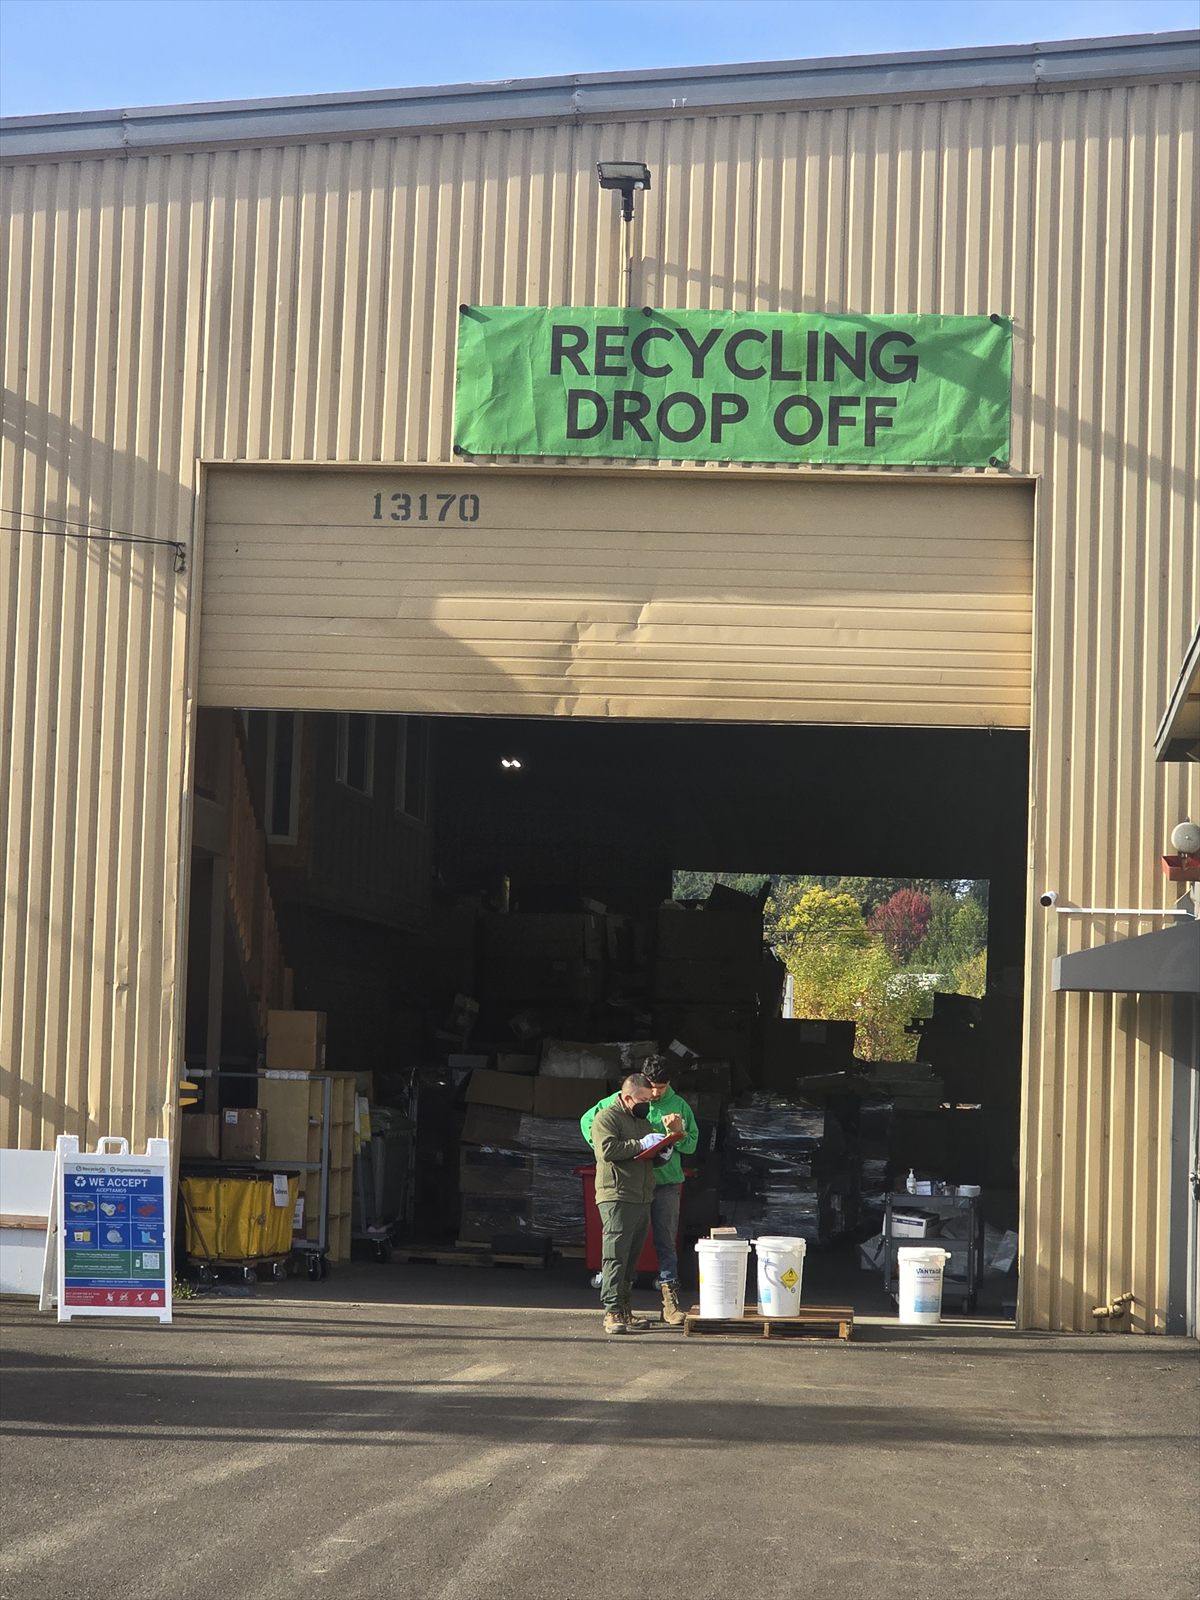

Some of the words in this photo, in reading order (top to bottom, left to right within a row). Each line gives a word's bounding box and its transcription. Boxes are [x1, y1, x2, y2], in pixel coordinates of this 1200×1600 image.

[549, 325, 919, 384] RECYCLING
[566, 388, 749, 445] DROP
[773, 395, 898, 448] OFF
[373, 492, 480, 522] 13170
[88, 1177, 105, 1187] WE
[107, 1178, 148, 1188] ACCEPT
